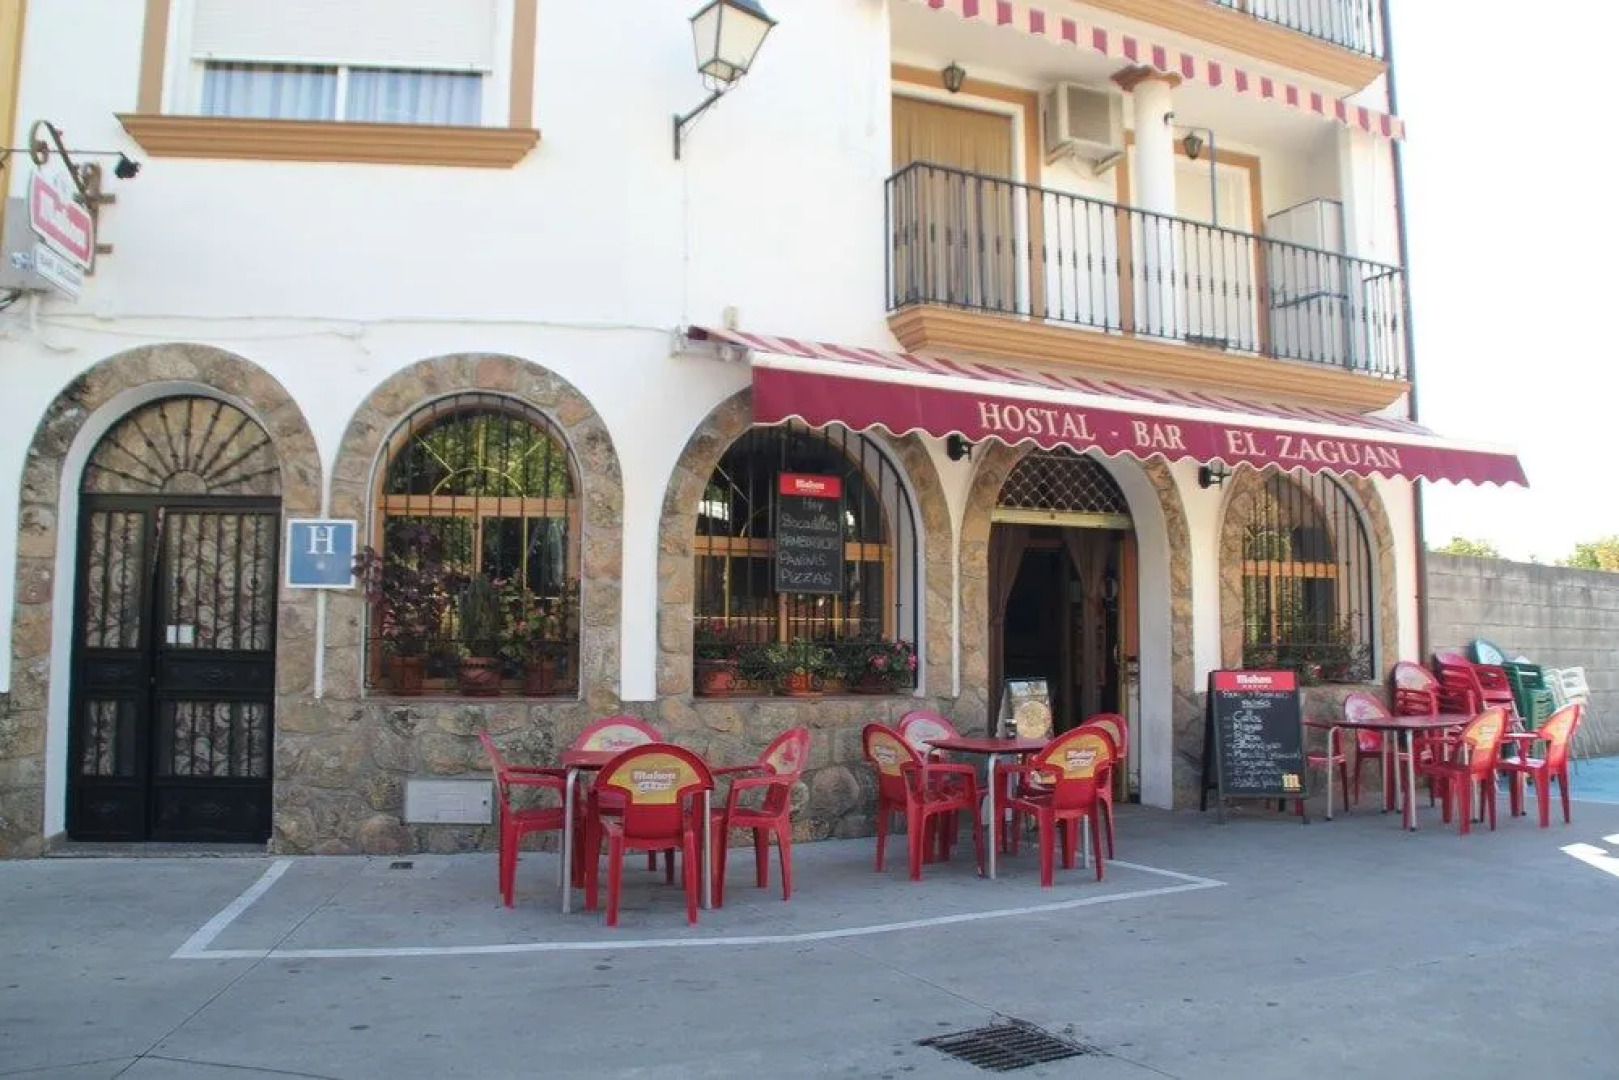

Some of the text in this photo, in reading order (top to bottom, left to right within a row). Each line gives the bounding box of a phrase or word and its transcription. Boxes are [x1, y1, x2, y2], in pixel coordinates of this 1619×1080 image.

[977, 401, 1096, 441] HOSTAL
[1132, 420, 1186, 450] BAR
[1224, 429, 1267, 456] EL
[1275, 435, 1402, 469] ZAGUAN
[306, 525, 337, 555] H
